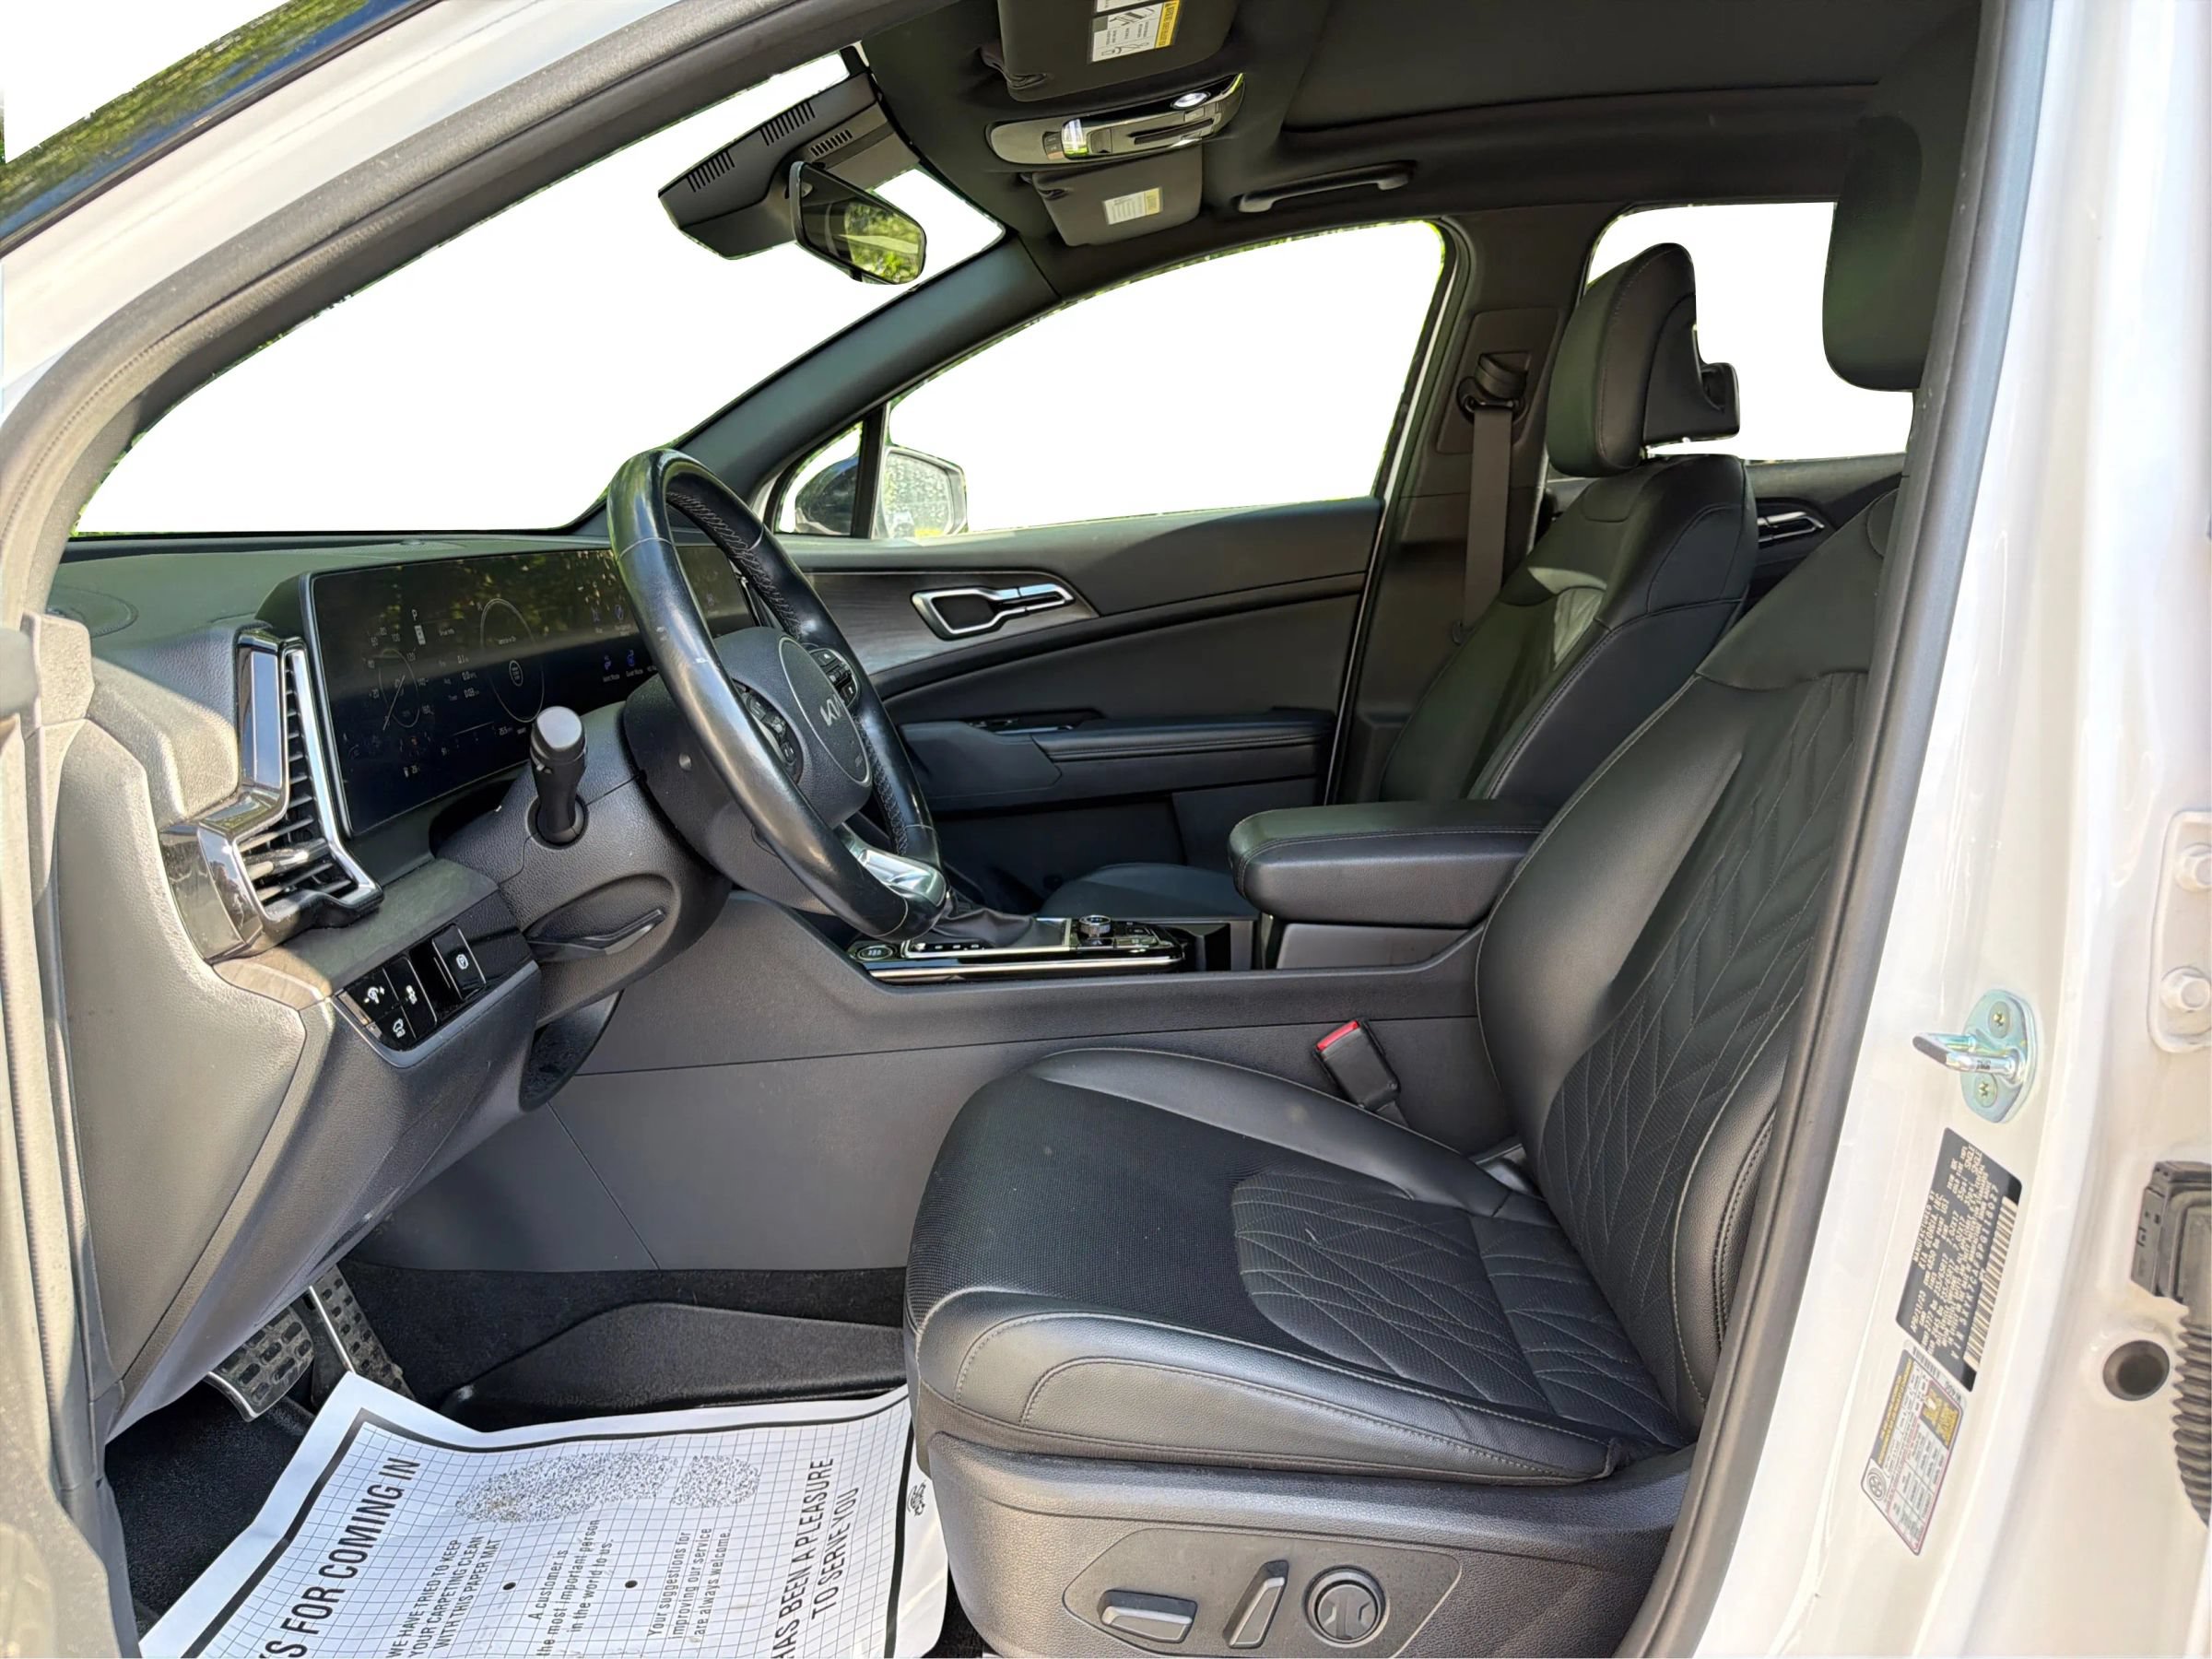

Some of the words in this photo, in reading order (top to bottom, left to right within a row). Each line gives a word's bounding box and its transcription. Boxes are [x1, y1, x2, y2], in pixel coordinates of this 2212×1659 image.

[794, 1458, 834, 1548] PLEASURE
[832, 1487, 859, 1526] YOU
[280, 1586, 346, 1635] FOR
[318, 1484, 405, 1579] COMING
[378, 1457, 420, 1480] IN
[580, 1520, 600, 1553] person
[599, 1539, 614, 1555] us.
[693, 1528, 712, 1564] service
[440, 1539, 462, 1565] KEEP
[553, 1549, 569, 1559] is
[592, 1558, 607, 1568] to
[711, 1528, 731, 1577] welcome.
[791, 1547, 817, 1564] A
[818, 1523, 851, 1585] SERVE
[431, 1565, 449, 1577] TO
[535, 1561, 563, 1609] customer
[555, 1556, 587, 1604] important
[582, 1570, 603, 1599] world
[647, 1612, 667, 1637] Your
[659, 1547, 687, 1609] suggestions
[675, 1532, 691, 1546] for
[688, 1566, 701, 1583] our
[407, 1627, 437, 1658] YOUR
[427, 1568, 466, 1623] CARPETING
[458, 1535, 484, 1567] CLEAN
[413, 1579, 441, 1608] TRIED
[433, 1621, 459, 1649] WITH
[449, 1594, 474, 1620] THIS
[464, 1561, 491, 1593] PAPER
[480, 1539, 502, 1559] MAT
[698, 1579, 721, 1615] always
[779, 1567, 809, 1619] BEEN
[811, 1585, 840, 1620] TO
[396, 1611, 424, 1638] HAVE
[528, 1612, 543, 1620] A
[547, 1607, 568, 1635] most
[572, 1603, 591, 1620] the
[668, 1585, 699, 1640] improving
[567, 1622, 583, 1632] in
[694, 1618, 708, 1635] are
[385, 1641, 408, 1659] WE
[535, 1639, 556, 1656] the
